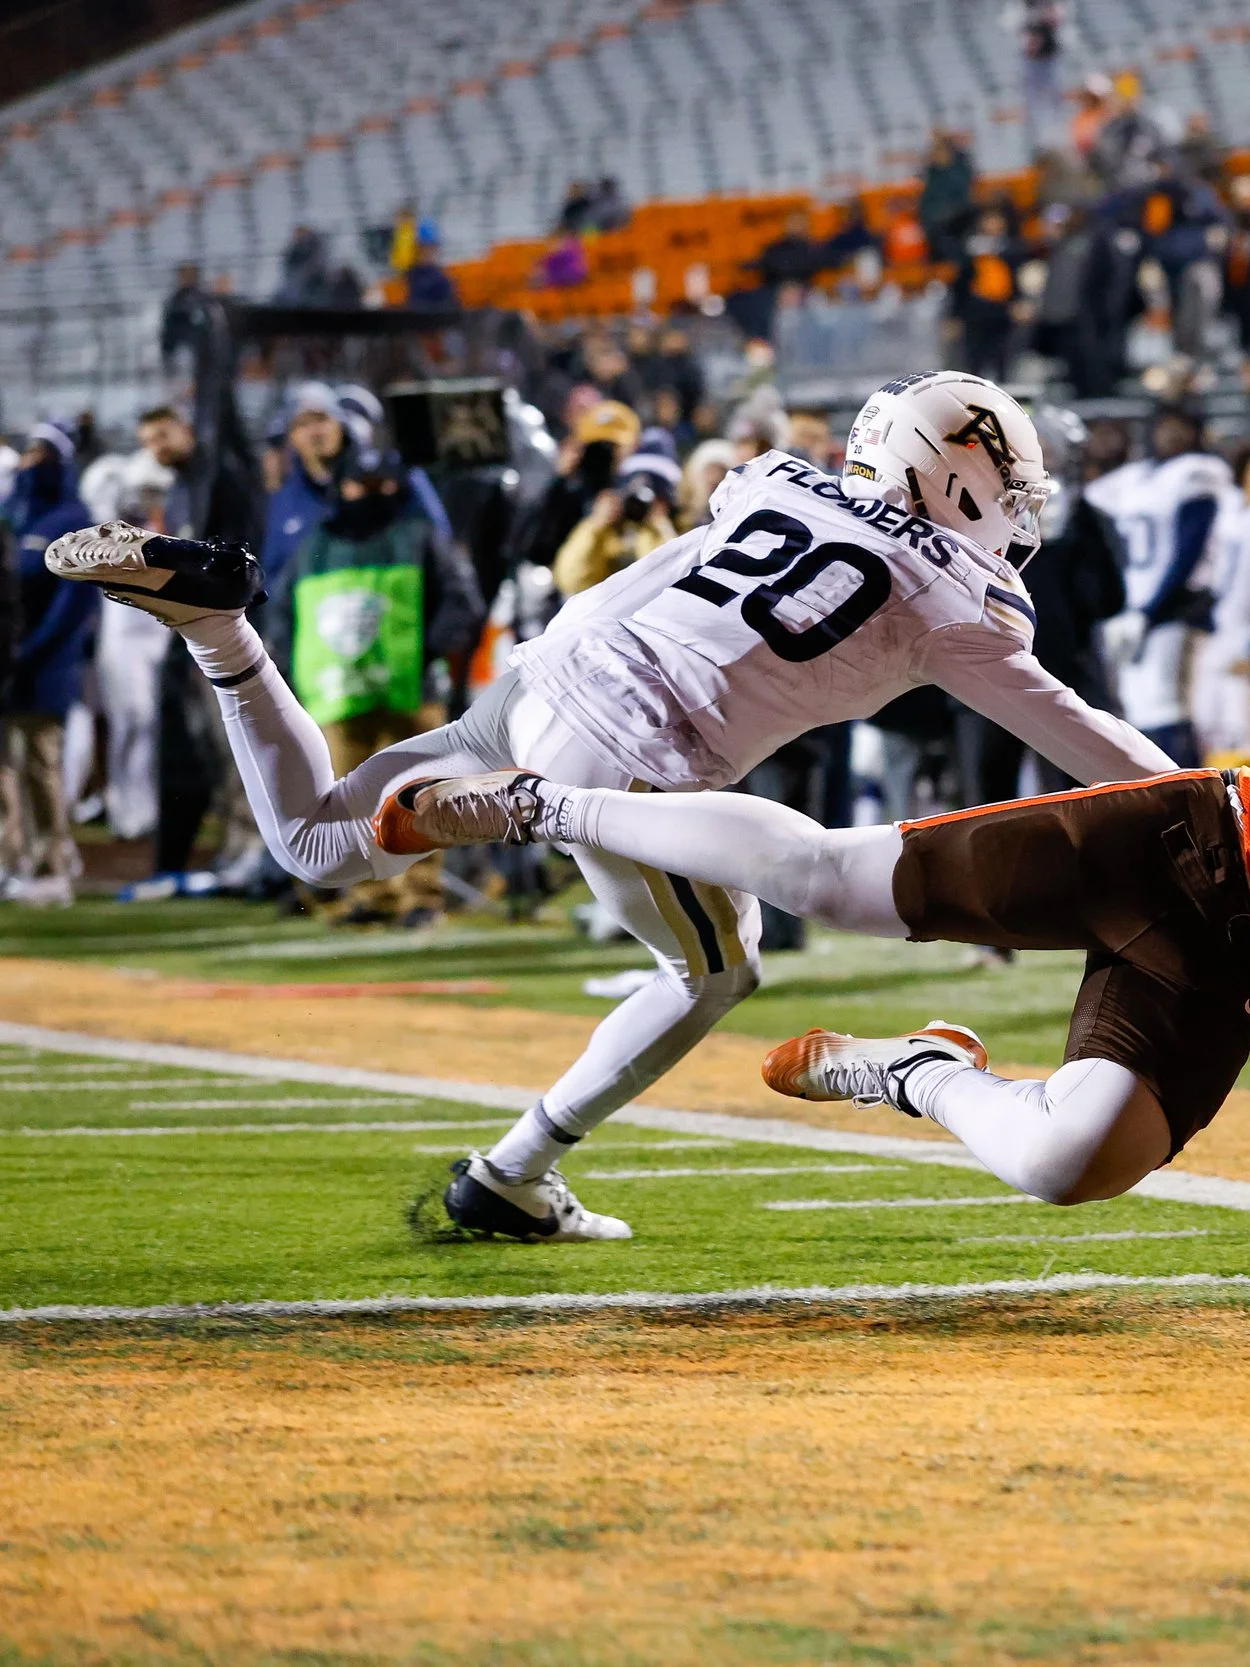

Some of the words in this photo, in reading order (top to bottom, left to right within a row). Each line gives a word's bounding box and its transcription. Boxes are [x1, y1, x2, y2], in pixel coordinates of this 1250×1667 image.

[853, 444, 863, 455] 20
[766, 460, 959, 568] FLOWERS
[672, 509, 892, 662] 20
